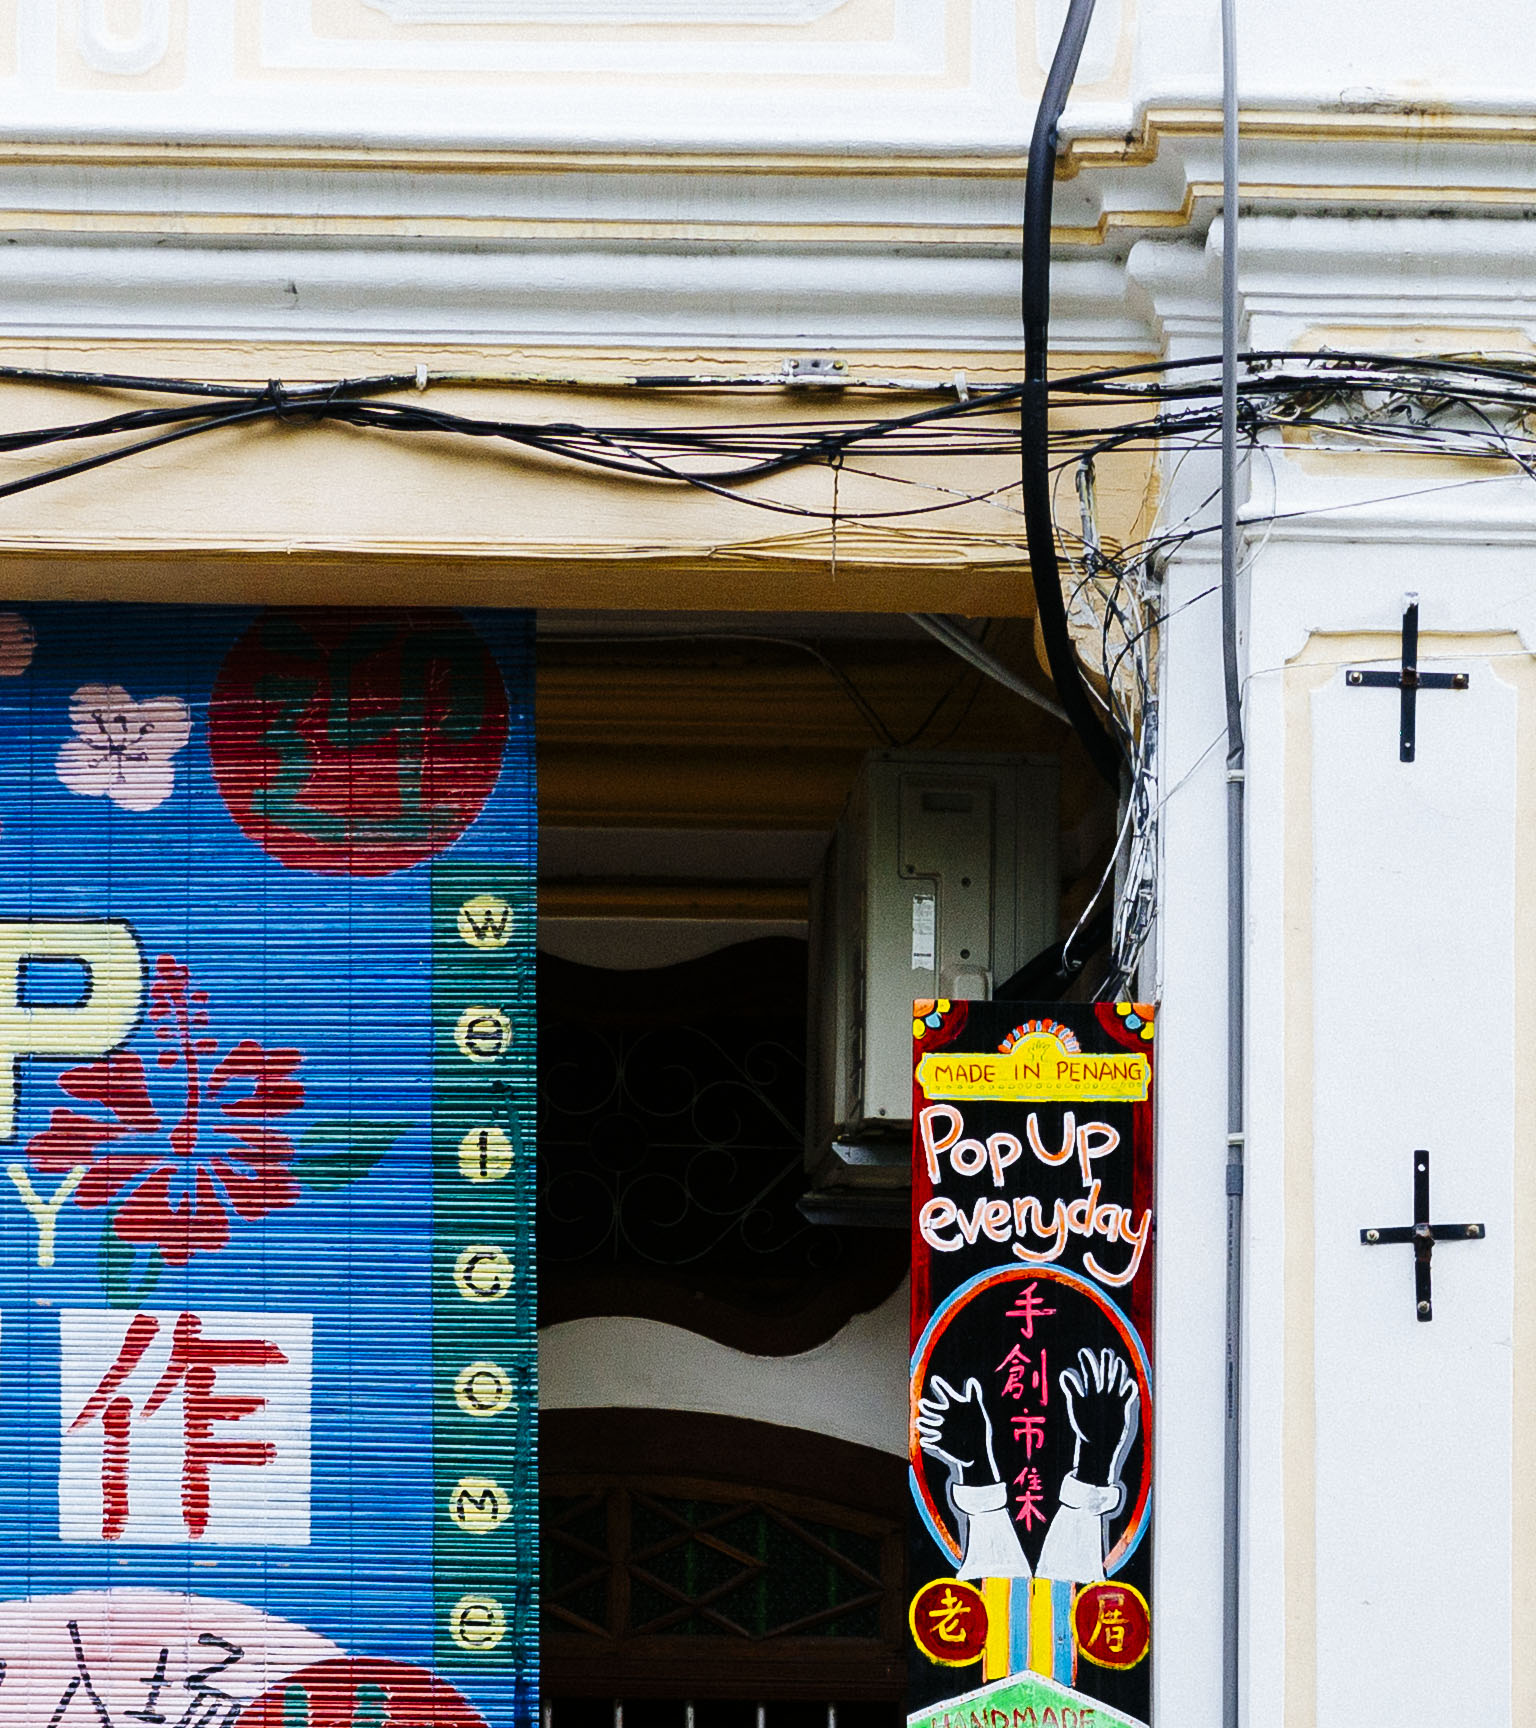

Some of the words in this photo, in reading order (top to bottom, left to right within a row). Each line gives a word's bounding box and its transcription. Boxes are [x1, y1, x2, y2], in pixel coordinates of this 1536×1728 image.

[934, 1063, 996, 1083] MADE
[1015, 1062, 1040, 1081] IN
[1056, 1061, 1143, 1082] PENANG
[919, 1103, 1023, 1188] Pop
[919, 1179, 1152, 1287] everyday
[995, 1281, 1056, 1533] 手創市集
[929, 1587, 971, 1643] 老
